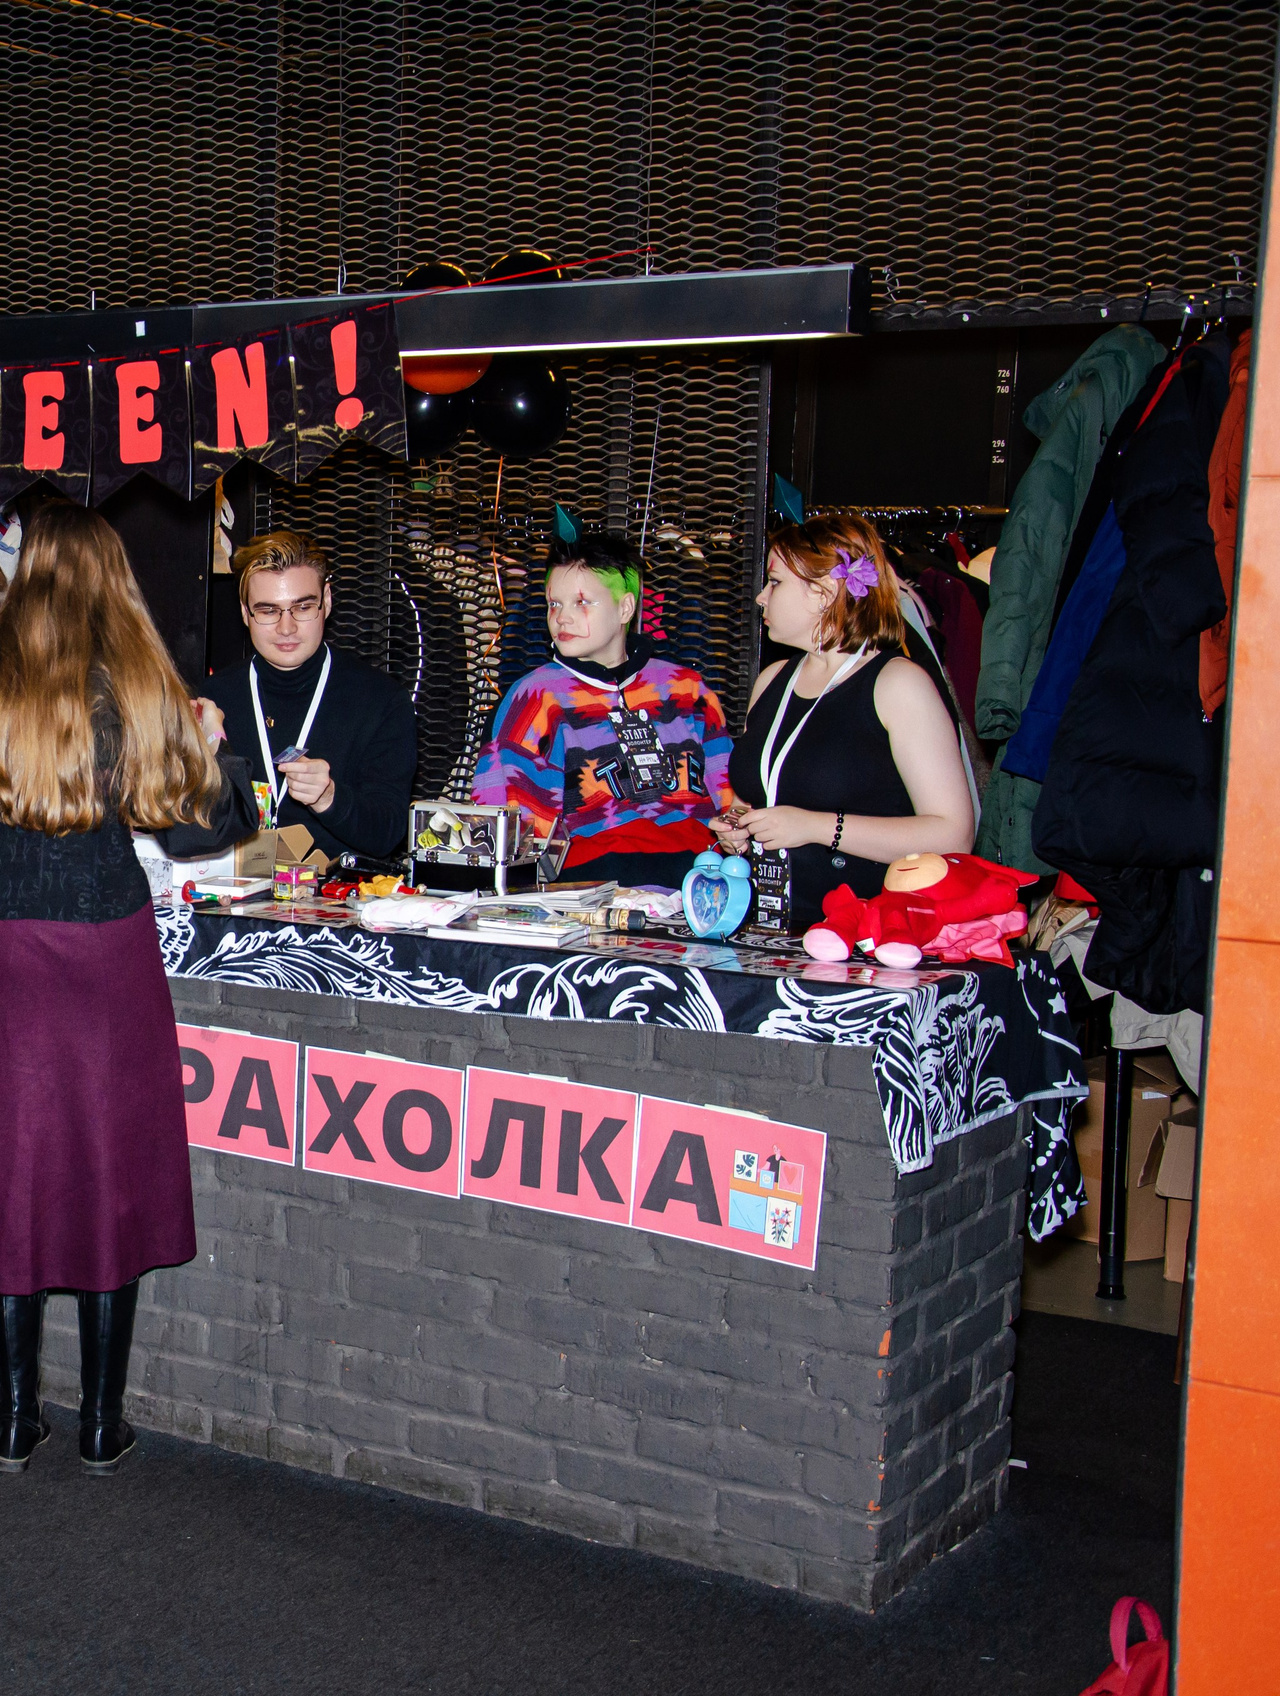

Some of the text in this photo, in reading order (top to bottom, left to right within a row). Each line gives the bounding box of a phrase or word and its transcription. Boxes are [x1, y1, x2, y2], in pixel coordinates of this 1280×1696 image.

[997, 369, 1011, 377] 726
[996, 385, 1010, 393] 760
[622, 728, 648, 740] STAFF
[758, 864, 782, 878] STAFF
